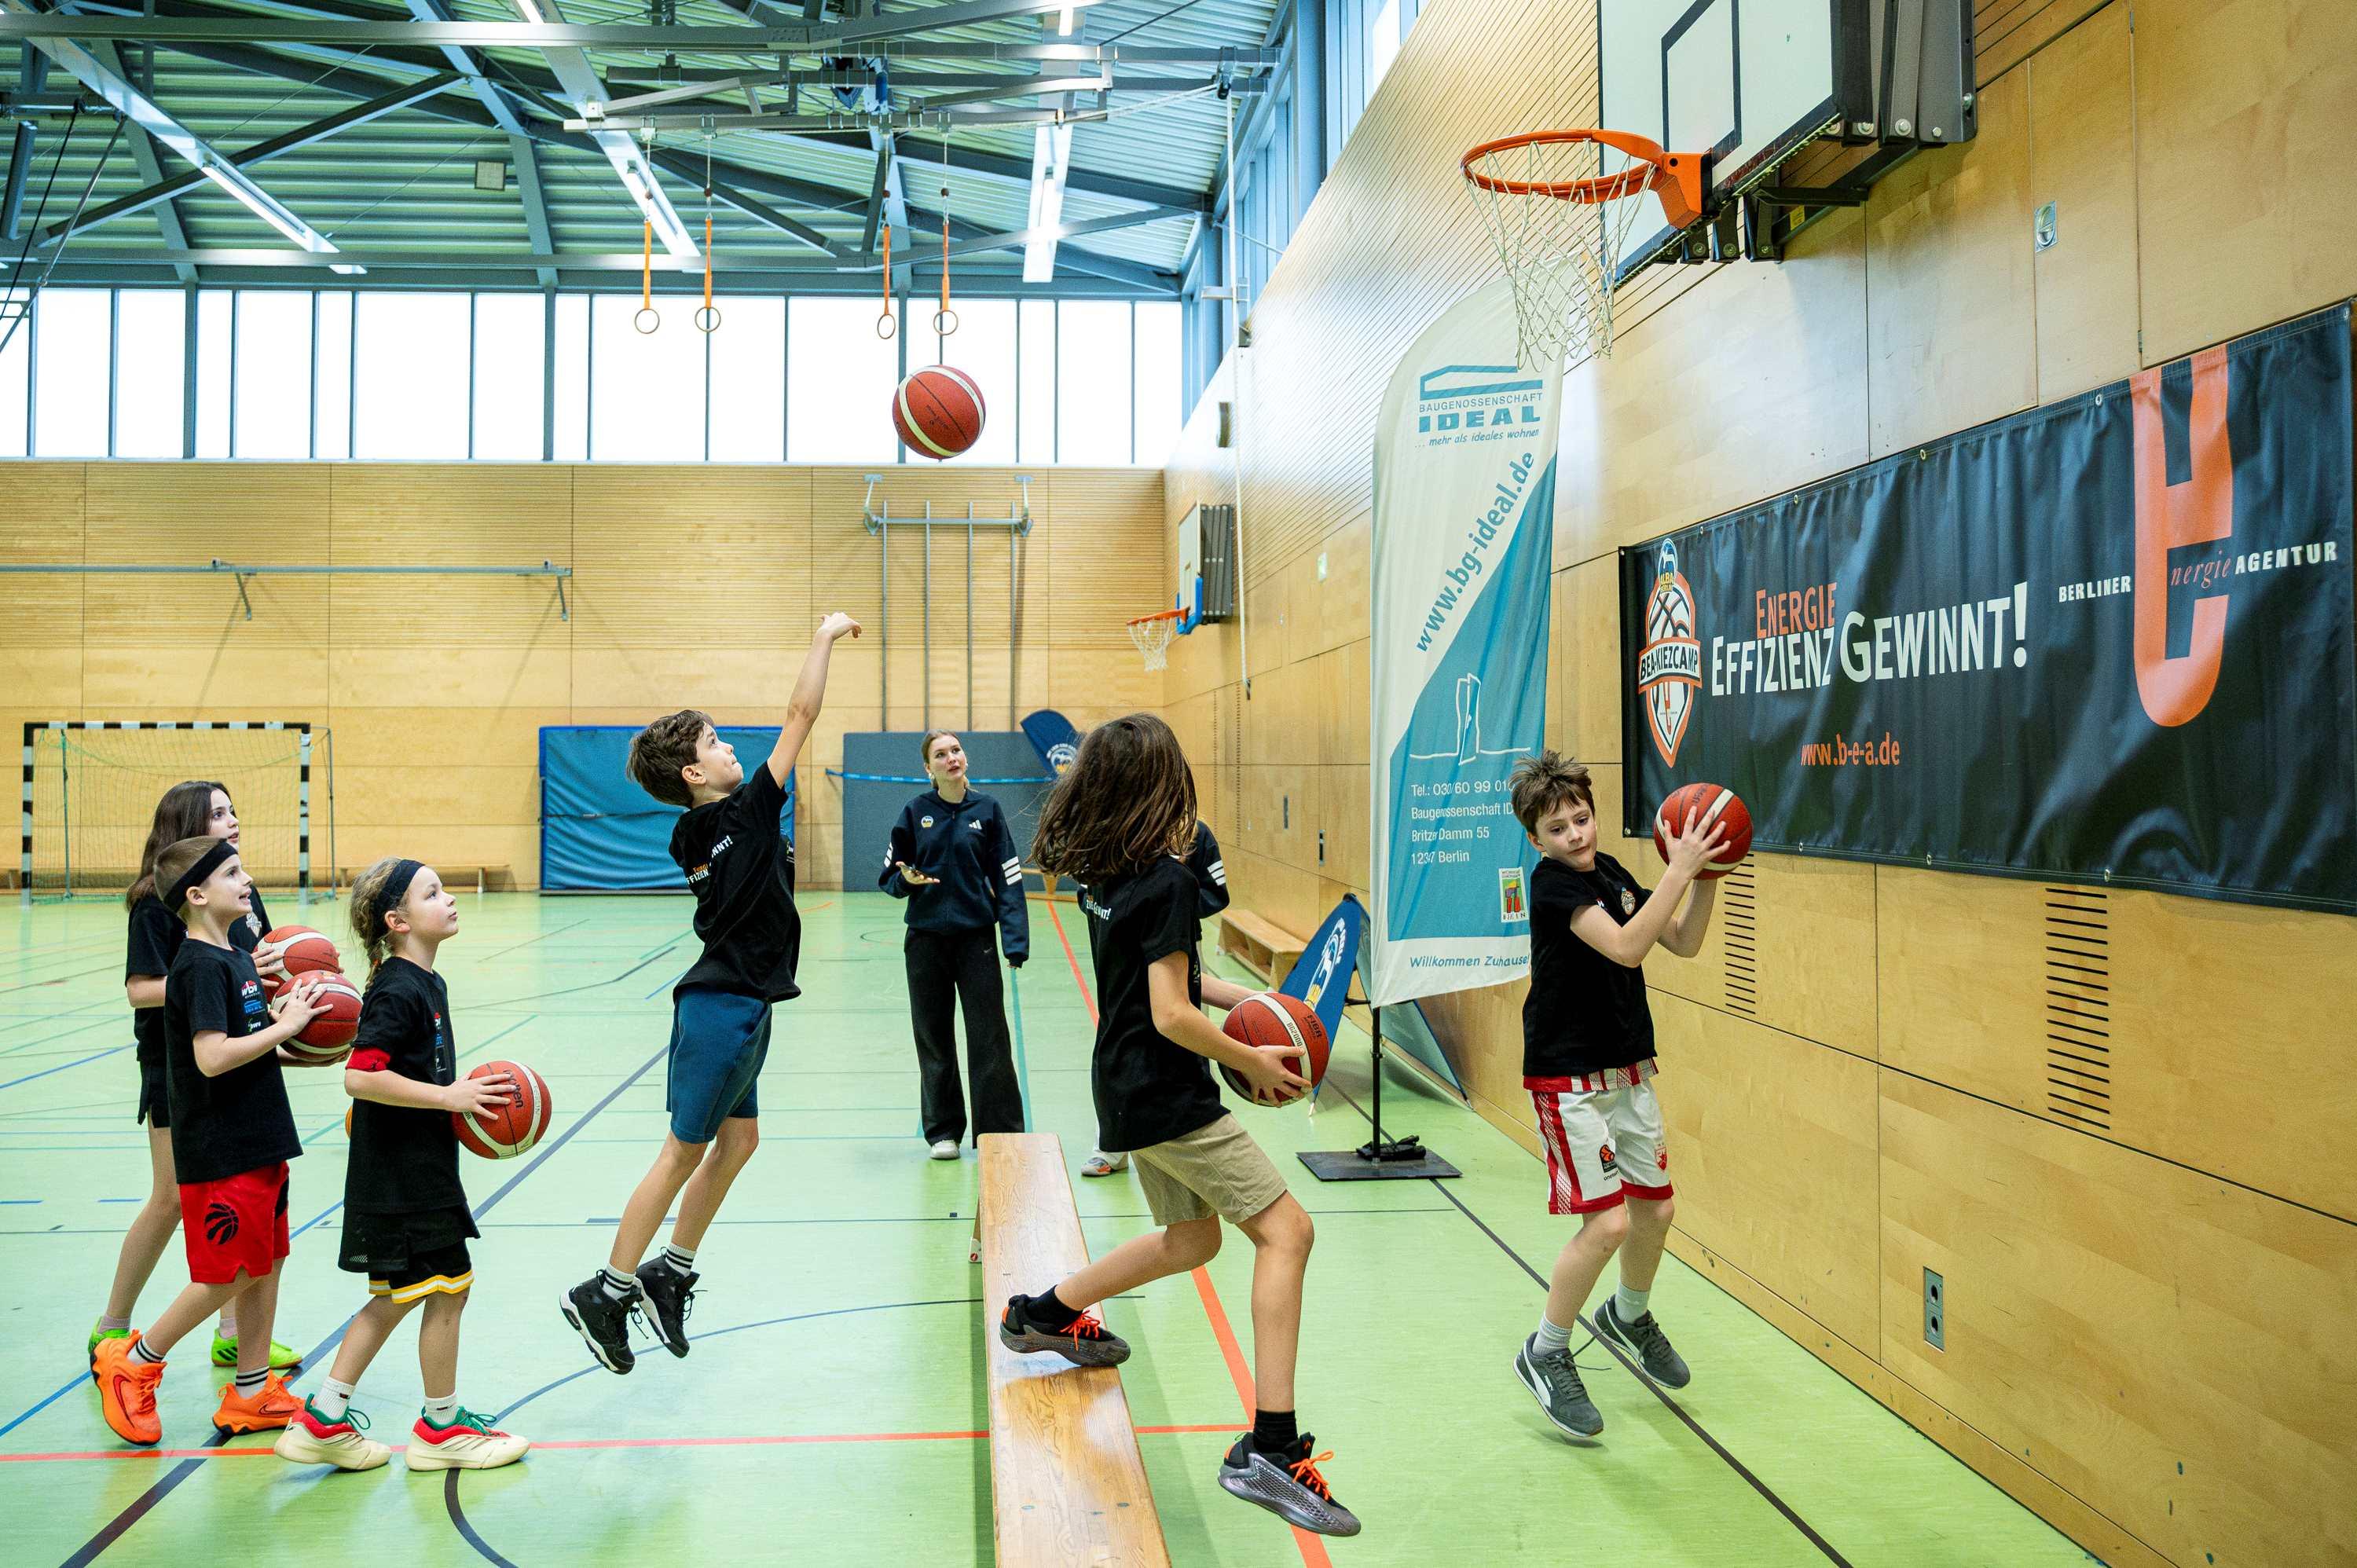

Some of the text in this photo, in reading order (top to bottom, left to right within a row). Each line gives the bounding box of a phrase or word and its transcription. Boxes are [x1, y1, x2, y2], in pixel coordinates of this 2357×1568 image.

[1419, 392, 1542, 413] BAUGENOSSENSCHAFT
[1419, 405, 1541, 433] IDEAL
[1429, 435, 1452, 447] mehr
[1454, 433, 1468, 444] als
[1472, 430, 1504, 442] ideales
[1507, 427, 1539, 438] wohnen
[1417, 452, 1534, 651] www.bg-ideal.de
[2058, 574, 2132, 603] BERLINER
[2234, 540, 2338, 576] AGENTUR
[1755, 581, 1838, 639] ENERGIE
[1711, 581, 2029, 696] EFFIZIENZ GEWINNT!
[1640, 646, 1698, 681] BEA-KIEZCAMP
[1800, 731, 1901, 767] www.b-e-a.de
[1411, 784, 1430, 797] Tel.:
[1474, 780, 1491, 793] 99
[1439, 828, 1473, 840] Damm
[1476, 826, 1490, 839] 55
[1439, 850, 1470, 863] Berlin
[1409, 954, 1480, 968] Willkommen
